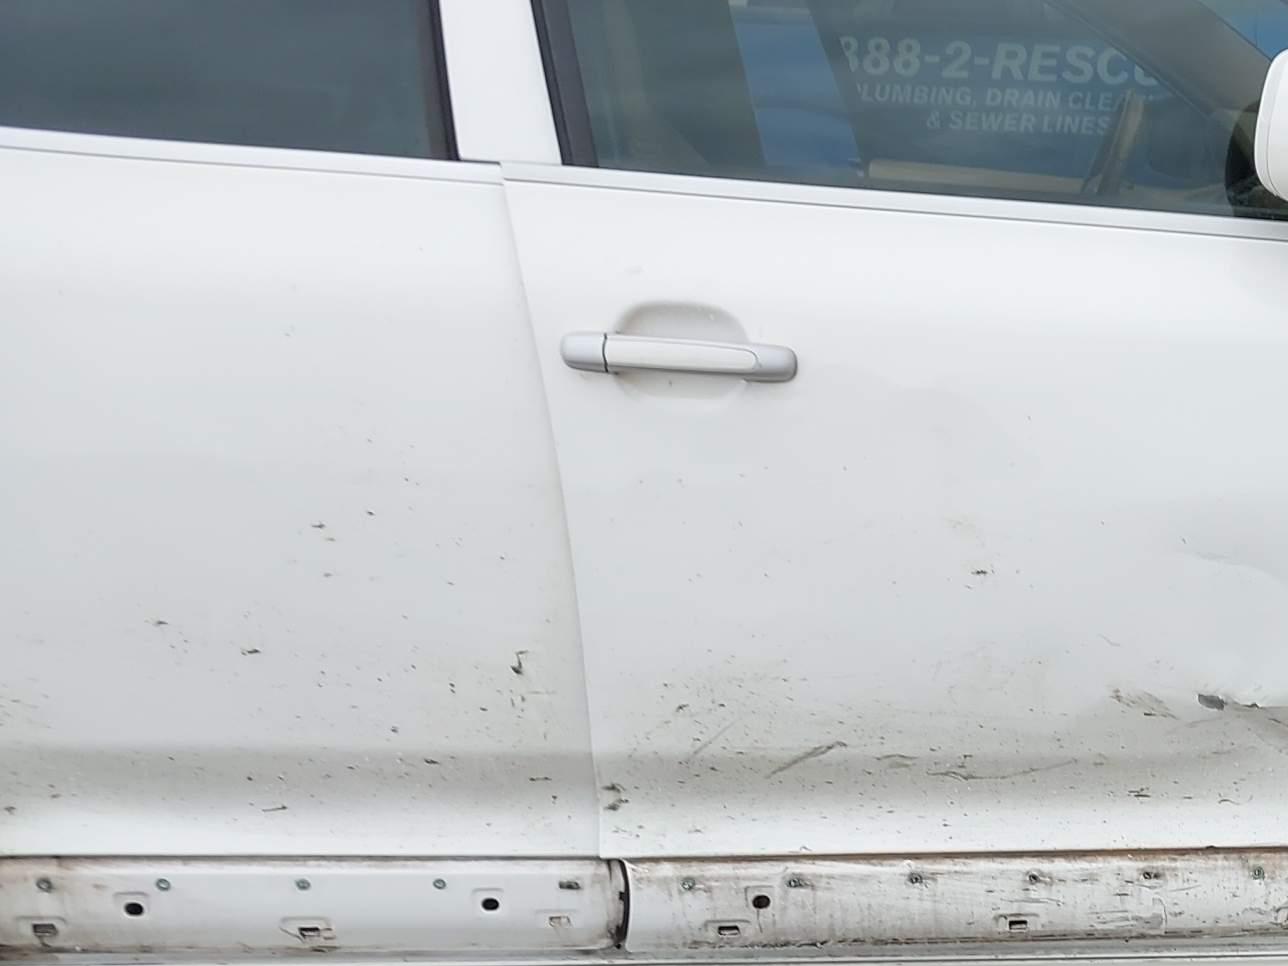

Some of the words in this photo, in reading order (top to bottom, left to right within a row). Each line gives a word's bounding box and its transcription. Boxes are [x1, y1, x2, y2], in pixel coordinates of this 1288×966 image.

[856, 83, 977, 108] LUMBING,
[986, 87, 1062, 108] DRAIN
[926, 110, 941, 129] &
[949, 110, 1036, 134] SEWER
[1041, 112, 1111, 136] LINES
